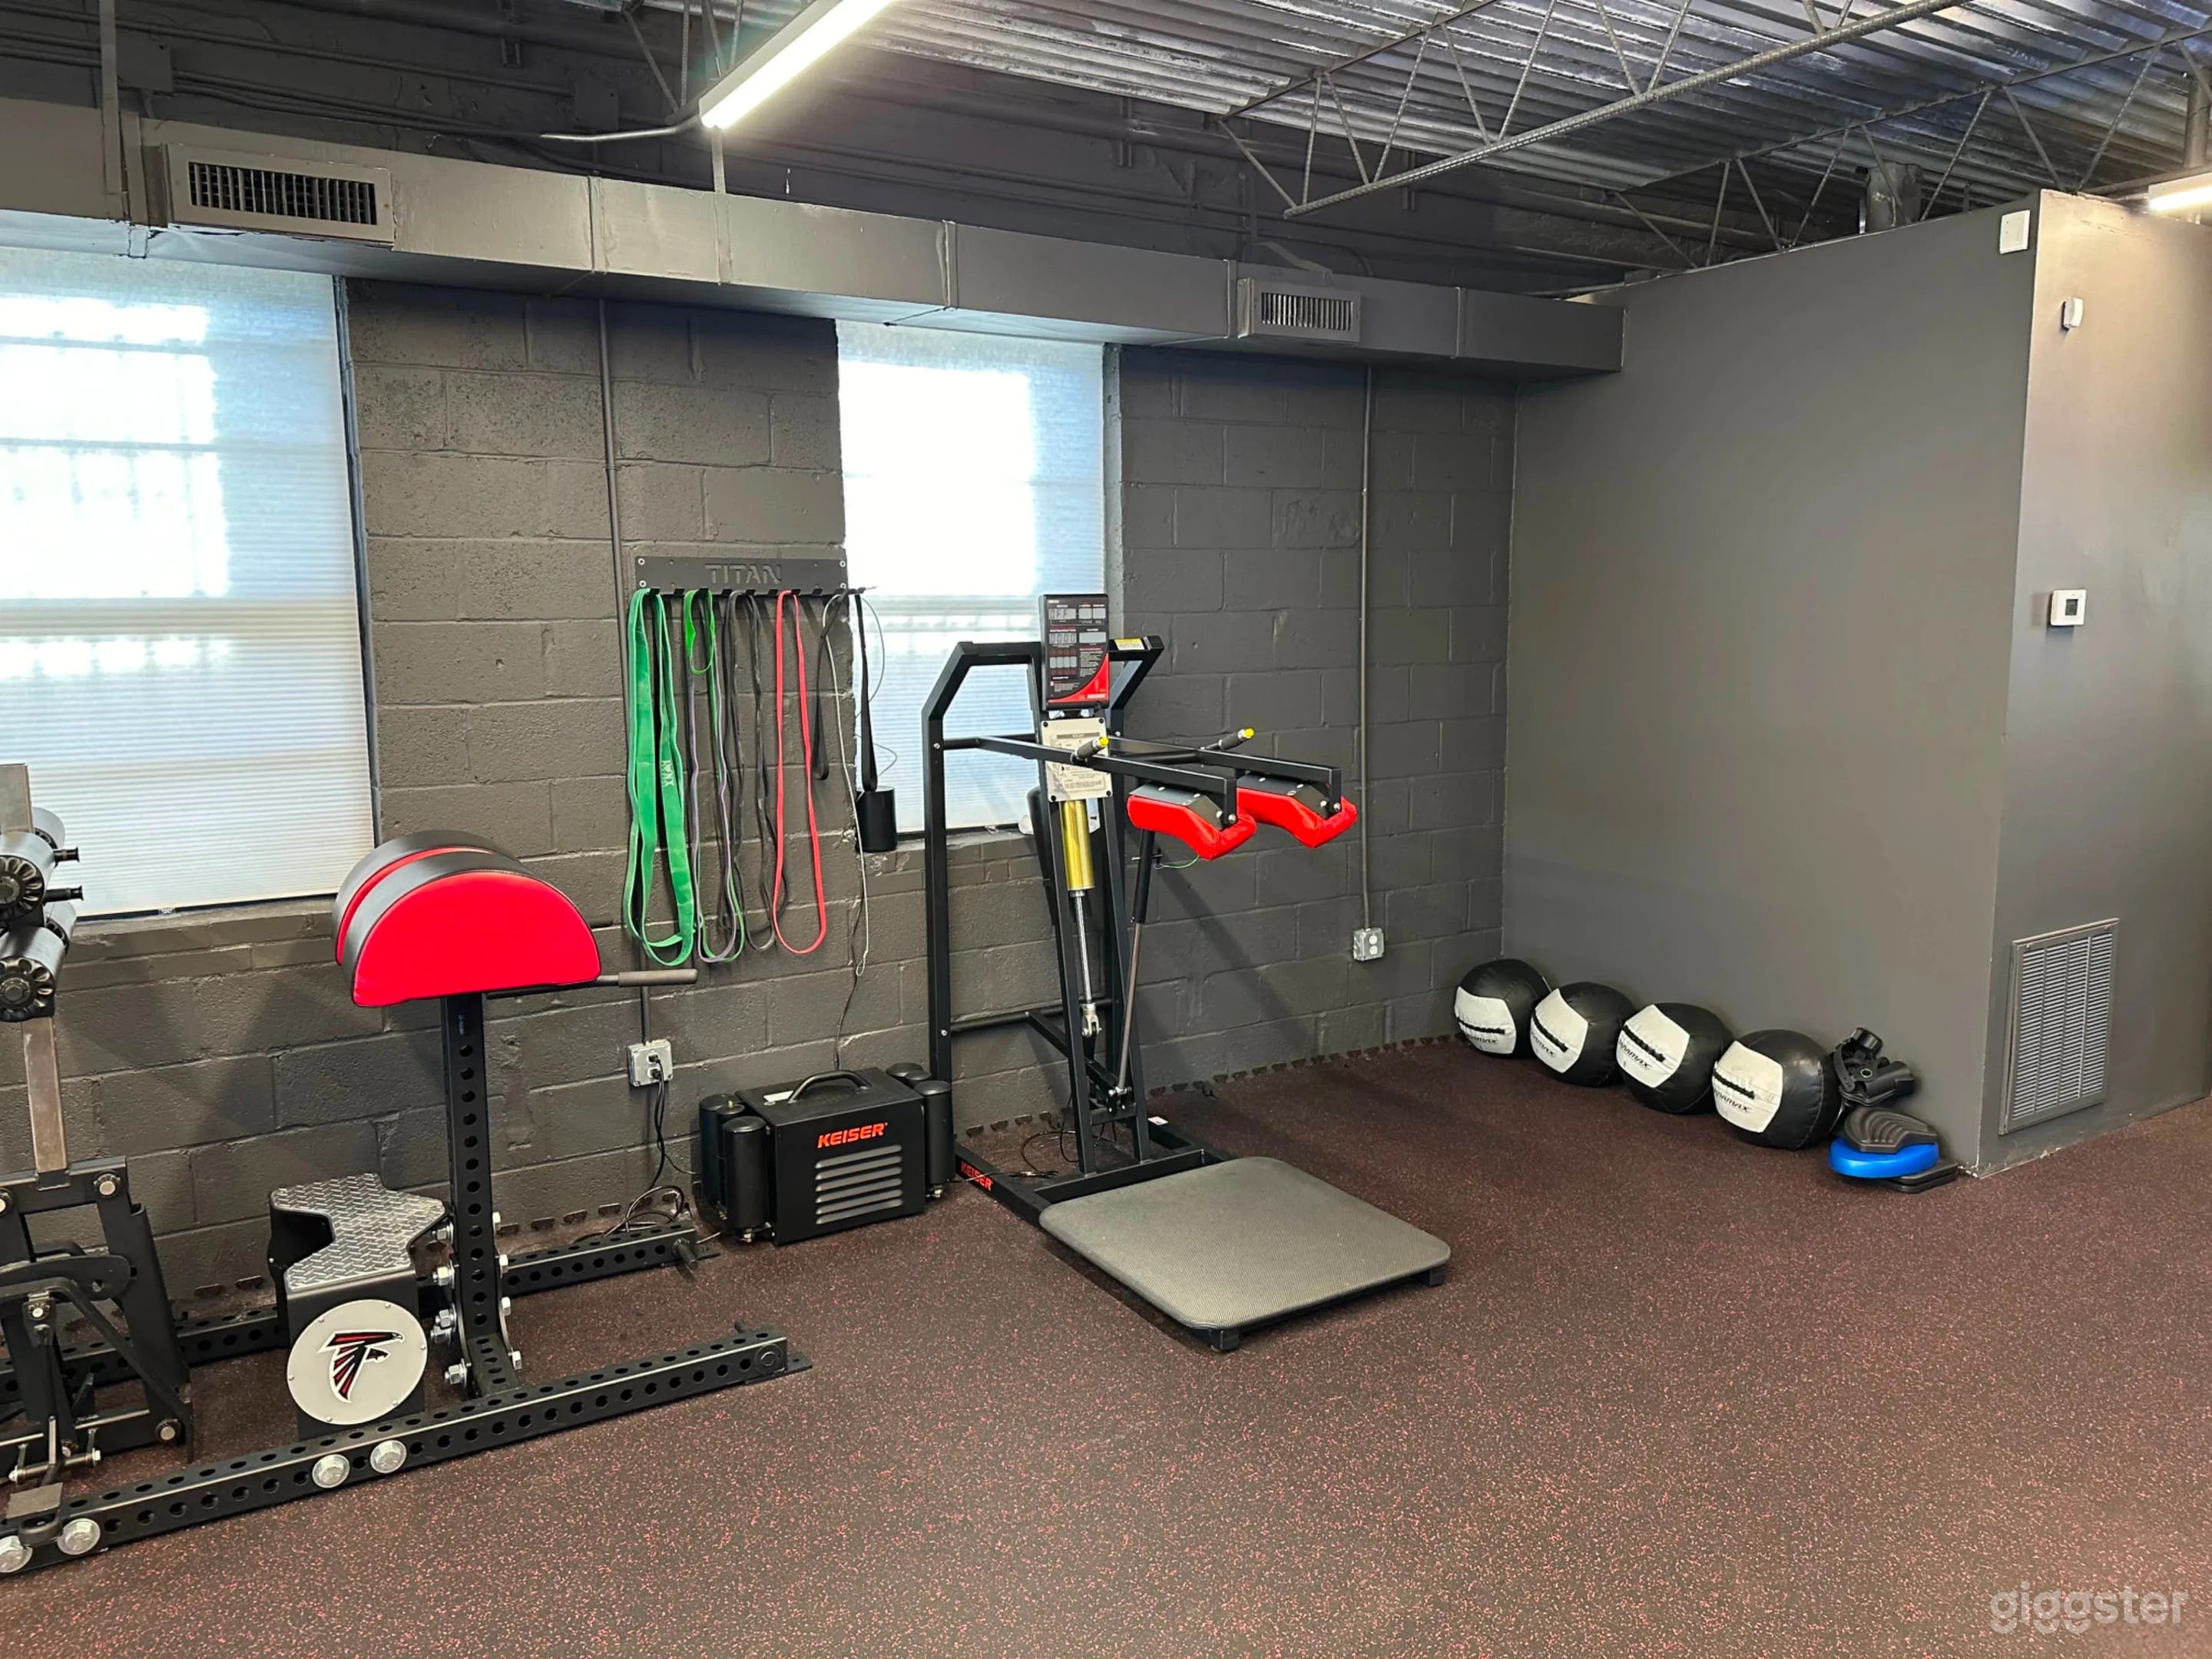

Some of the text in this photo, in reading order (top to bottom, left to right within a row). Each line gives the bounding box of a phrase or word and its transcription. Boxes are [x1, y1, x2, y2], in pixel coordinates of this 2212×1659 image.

[705, 563, 782, 584] TITAN
[817, 1123, 886, 1148] KEISER
[961, 1161, 993, 1191] KEISER
